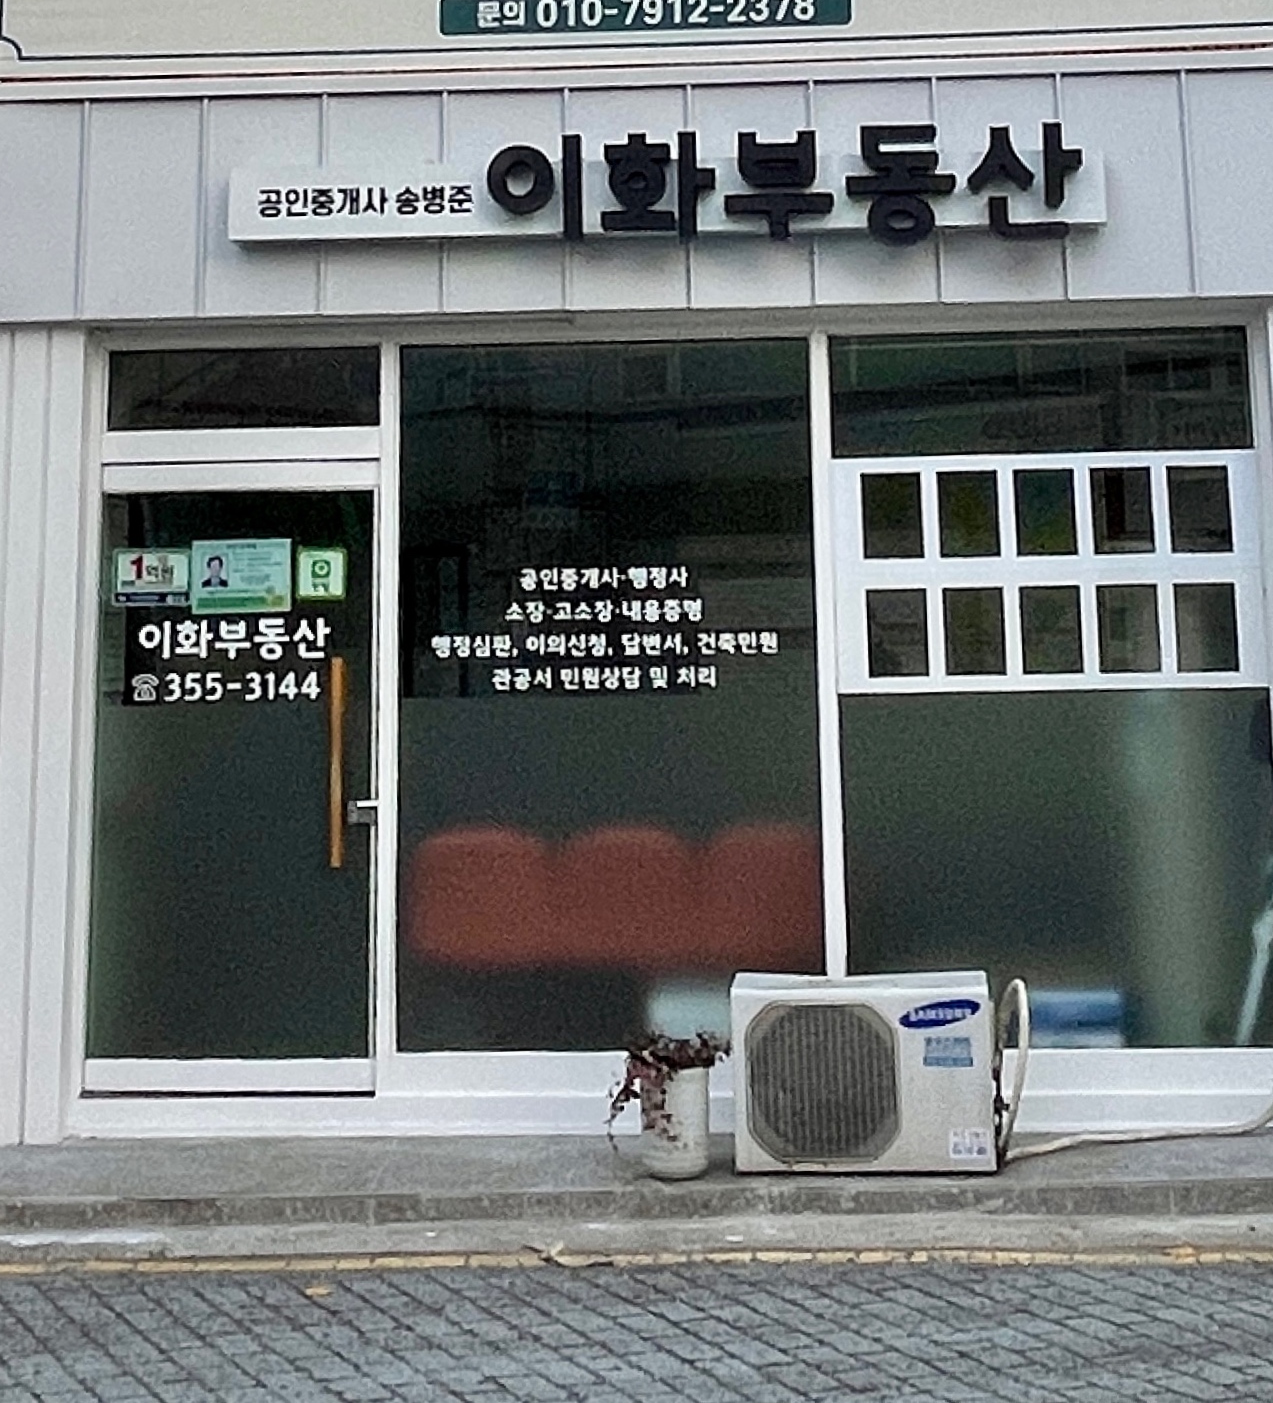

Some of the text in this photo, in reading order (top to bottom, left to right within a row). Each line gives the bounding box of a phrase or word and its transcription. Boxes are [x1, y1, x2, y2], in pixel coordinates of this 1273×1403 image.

[476, 0, 526, 28] 문의
[257, 120, 1084, 247] 공인중개사 송병준 이화부동산
[138, 617, 331, 660] 이화부동산
[526, 632, 614, 657] 이의신청,
[621, 631, 689, 655] 답변서,
[696, 631, 779, 655] 건축민원
[163, 670, 322, 702] 355-3144
[491, 665, 718, 691] 관공서 민원상담 및 처리
